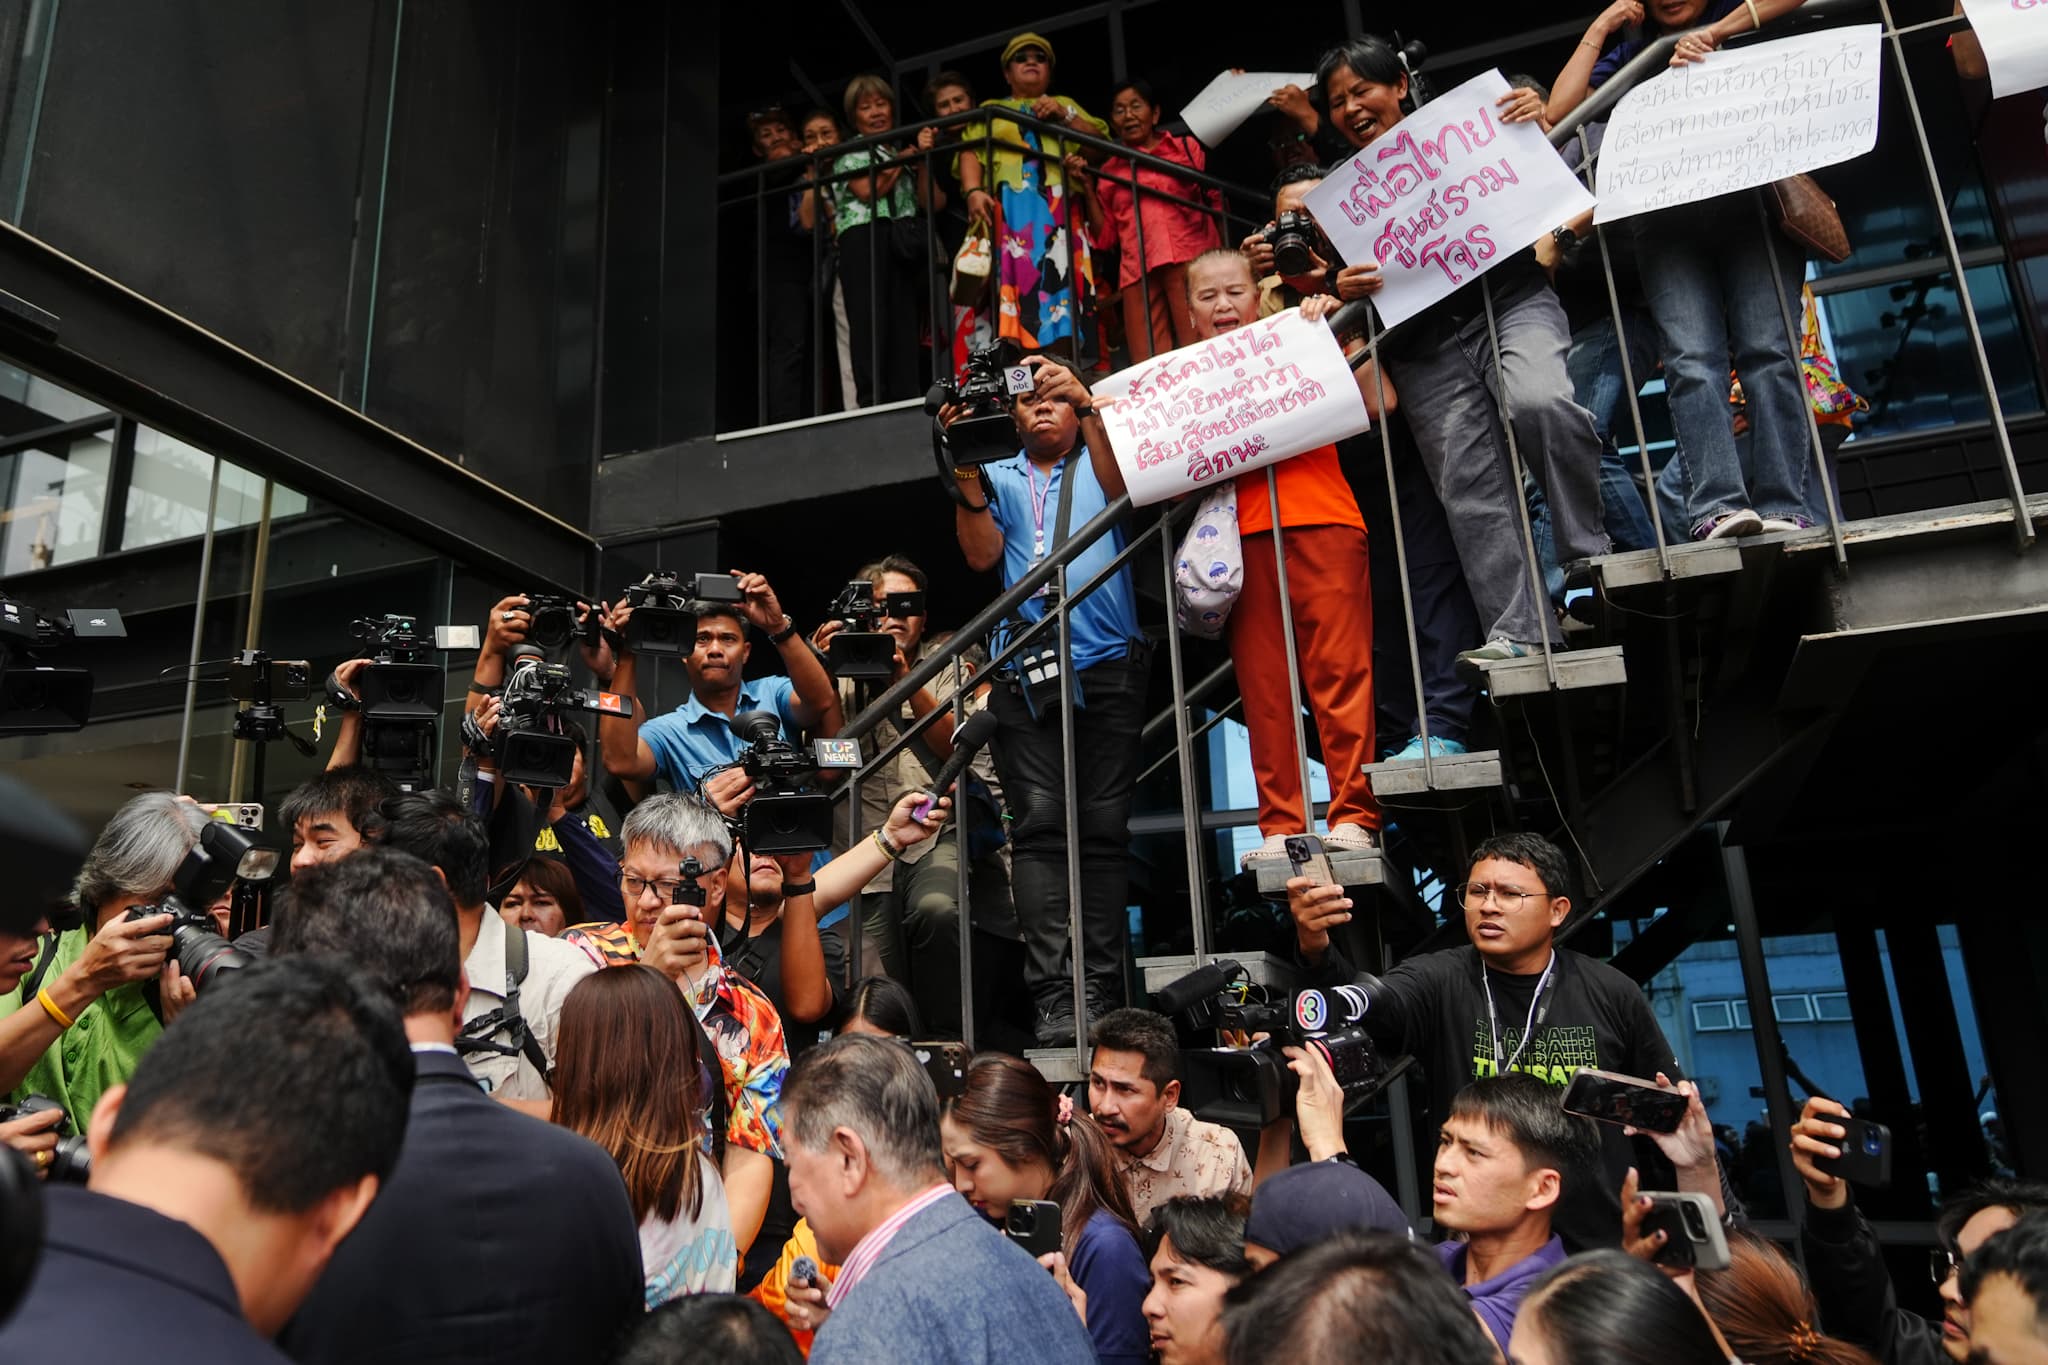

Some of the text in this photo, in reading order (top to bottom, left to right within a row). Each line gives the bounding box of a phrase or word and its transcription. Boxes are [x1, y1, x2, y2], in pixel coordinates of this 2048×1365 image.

[1339, 106, 1497, 226] เพื่อไทย
[1373, 157, 1520, 270] ศูนย์รวม
[1420, 223, 1498, 285] โจร
[1013, 382, 1030, 391] nbt
[1187, 433, 1271, 482] อีกนะ
[821, 741, 855, 753] TOP
[823, 752, 857, 762] NEWS
